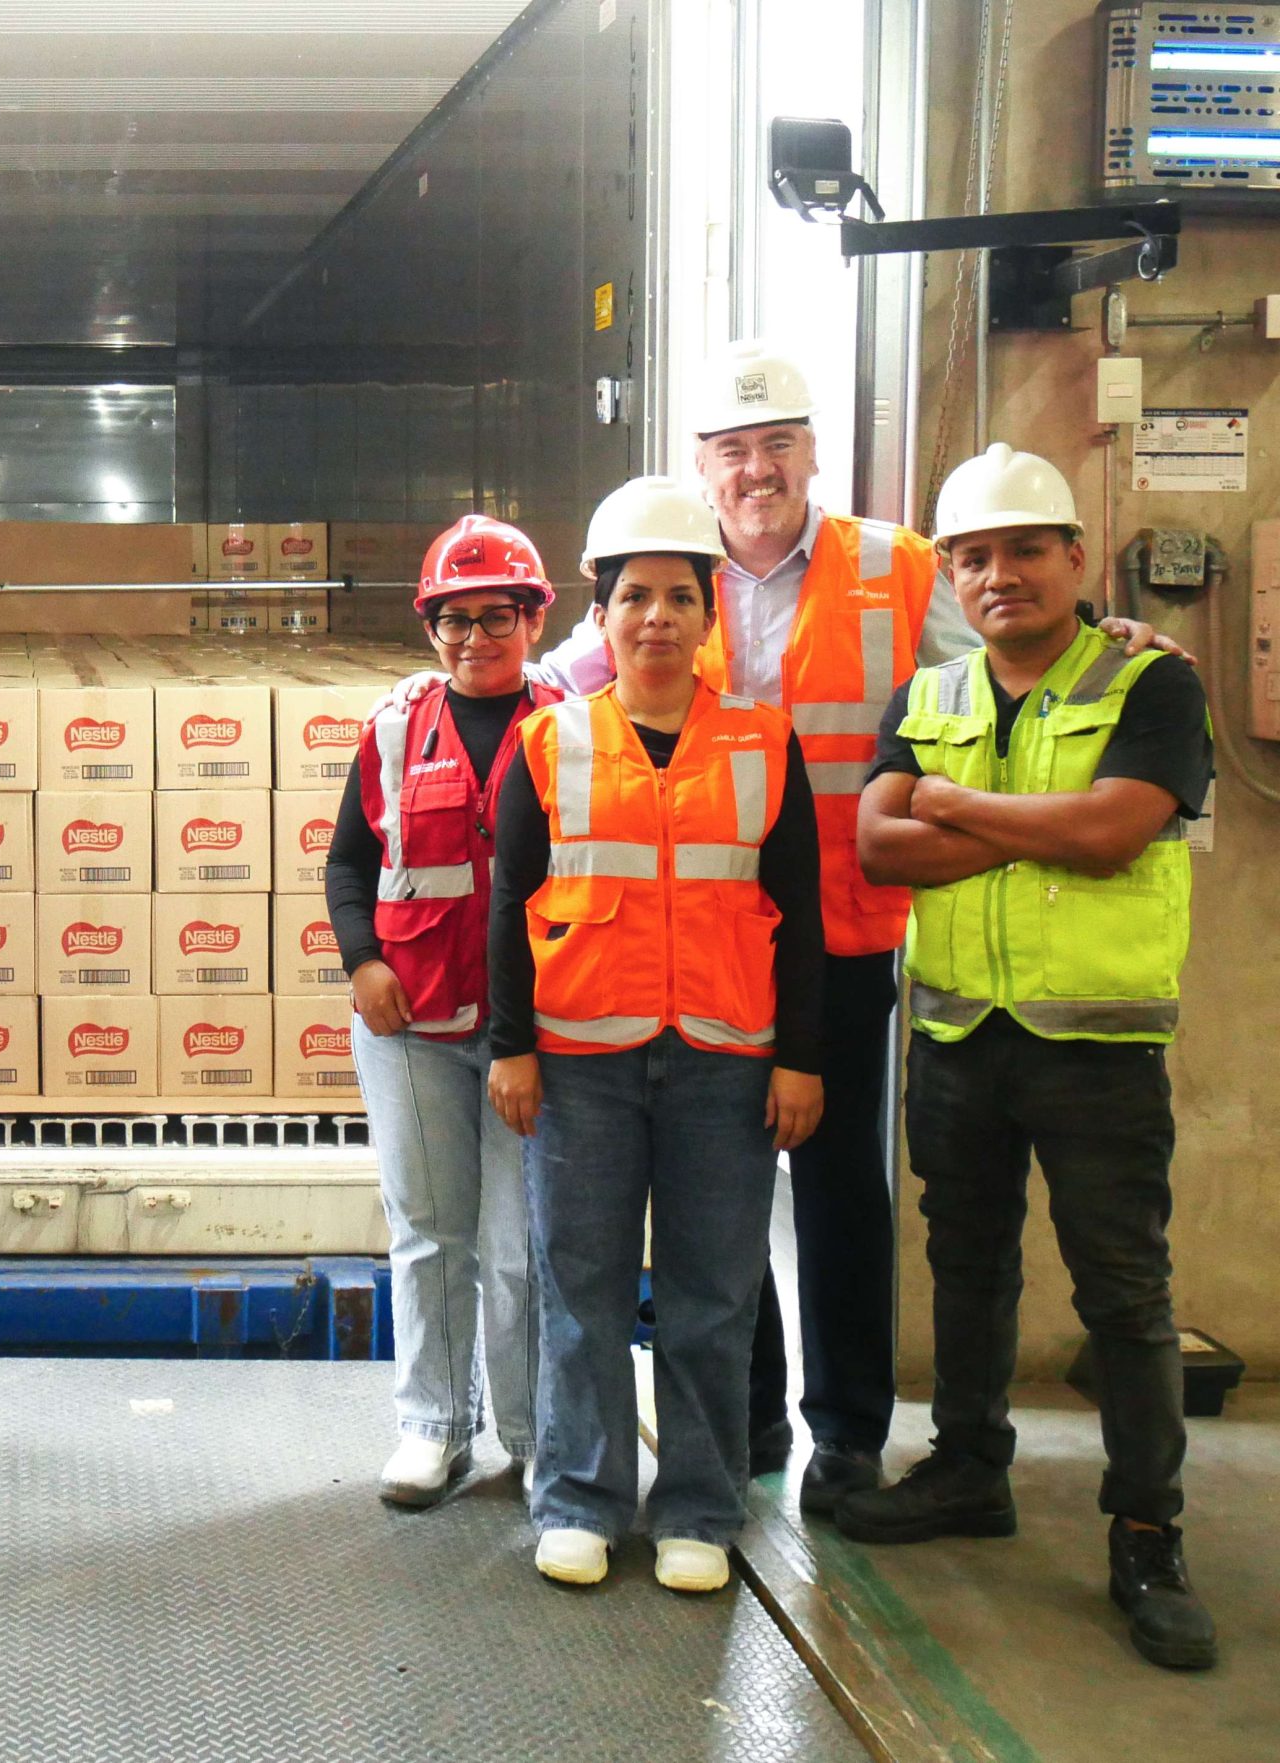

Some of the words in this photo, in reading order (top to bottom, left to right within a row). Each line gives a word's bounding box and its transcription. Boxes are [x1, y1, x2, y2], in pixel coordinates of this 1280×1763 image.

[70, 725, 120, 741] Nestlé
[186, 723, 236, 739] Nestlé
[309, 724, 359, 739] Nestlé
[67, 827, 117, 843] Nestlé
[186, 826, 236, 842] Nestlé
[305, 829, 335, 843] Nes
[67, 930, 117, 946] Nestlé
[185, 928, 235, 944] Nestlé
[306, 930, 338, 944] Nes
[73, 1031, 123, 1047] Nestlé
[188, 1030, 238, 1046] Nestlé
